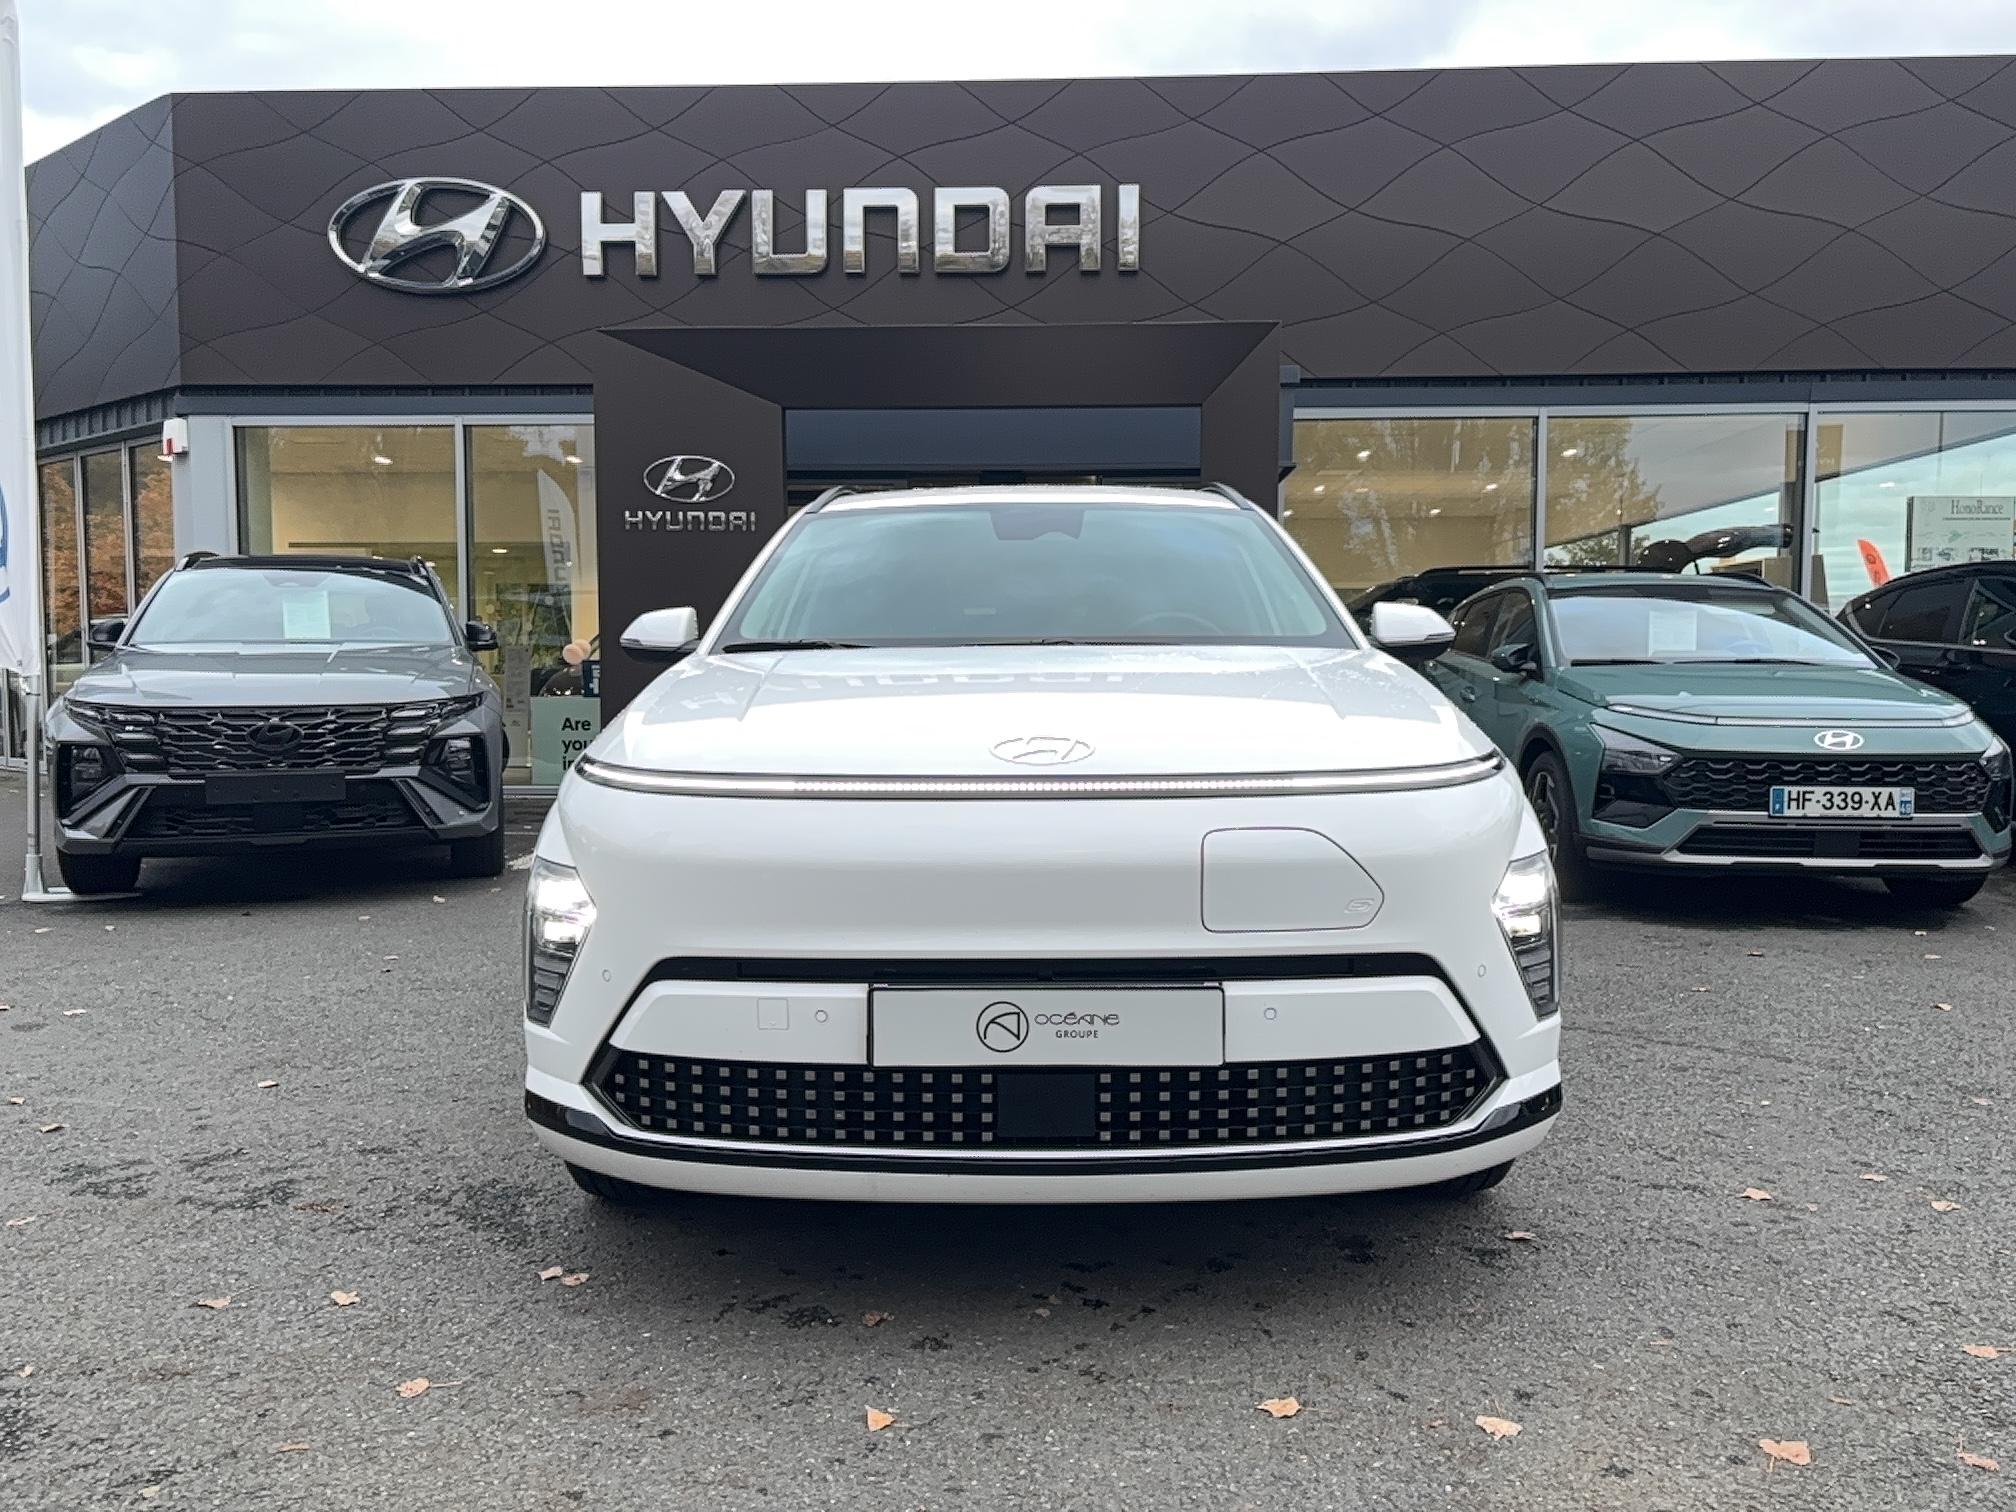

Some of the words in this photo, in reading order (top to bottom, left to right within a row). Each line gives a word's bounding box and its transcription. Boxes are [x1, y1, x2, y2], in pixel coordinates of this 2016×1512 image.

[580, 184, 1140, 276] HYUNDAI
[624, 510, 756, 532] HYUNDAI
[562, 717, 591, 731] Are
[1787, 790, 1897, 812] HF-339-XA
[1055, 1029, 1099, 1039] GROUPE
